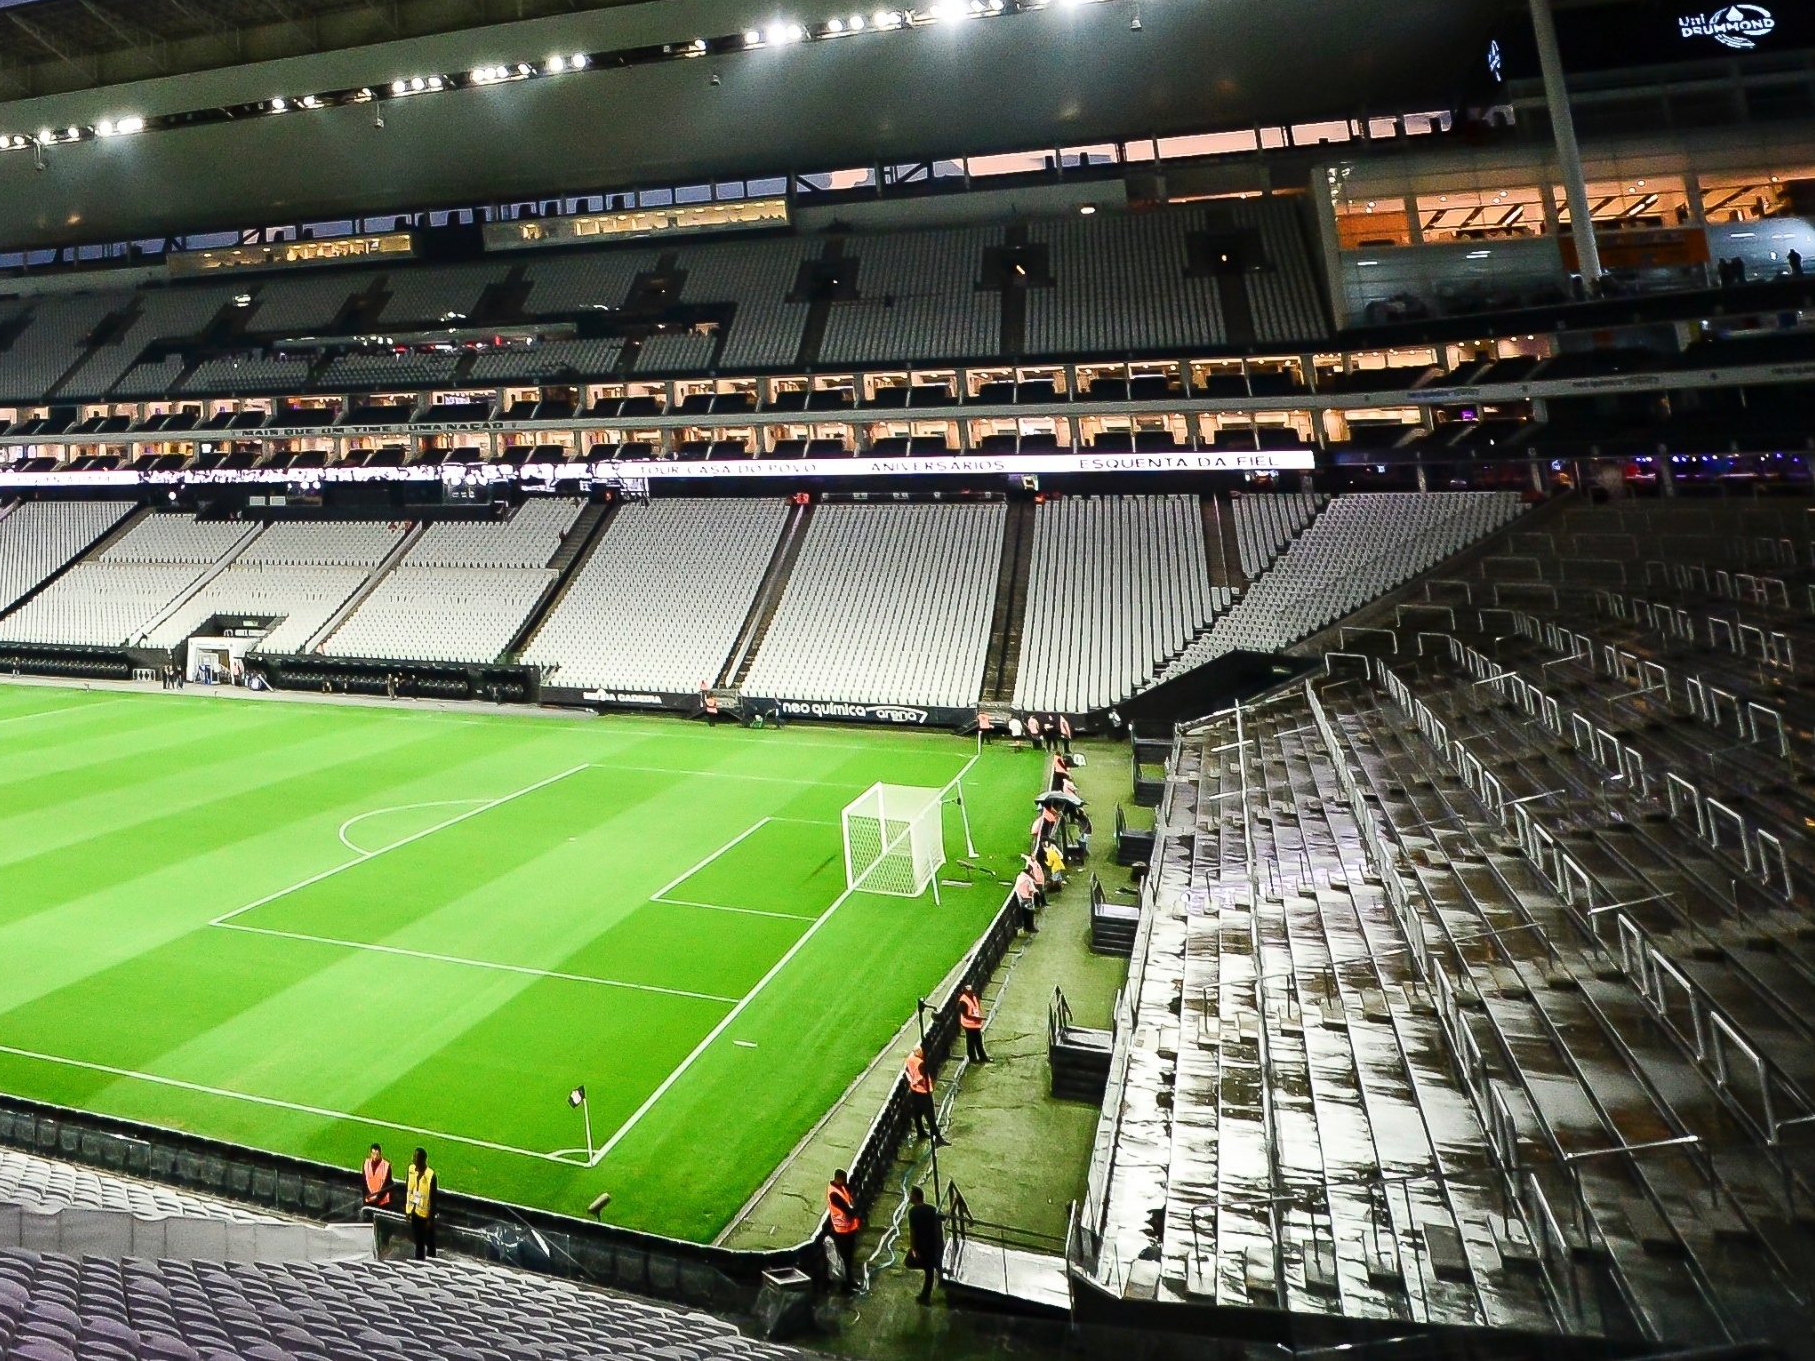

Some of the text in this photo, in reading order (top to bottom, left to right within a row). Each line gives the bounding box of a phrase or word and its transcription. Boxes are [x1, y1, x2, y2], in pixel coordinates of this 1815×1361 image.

[1681, 18, 1775, 37] DRUMMOND
[1079, 455, 1280, 469] ESQUENTA DA FIEL
[782, 702, 810, 714] neo
